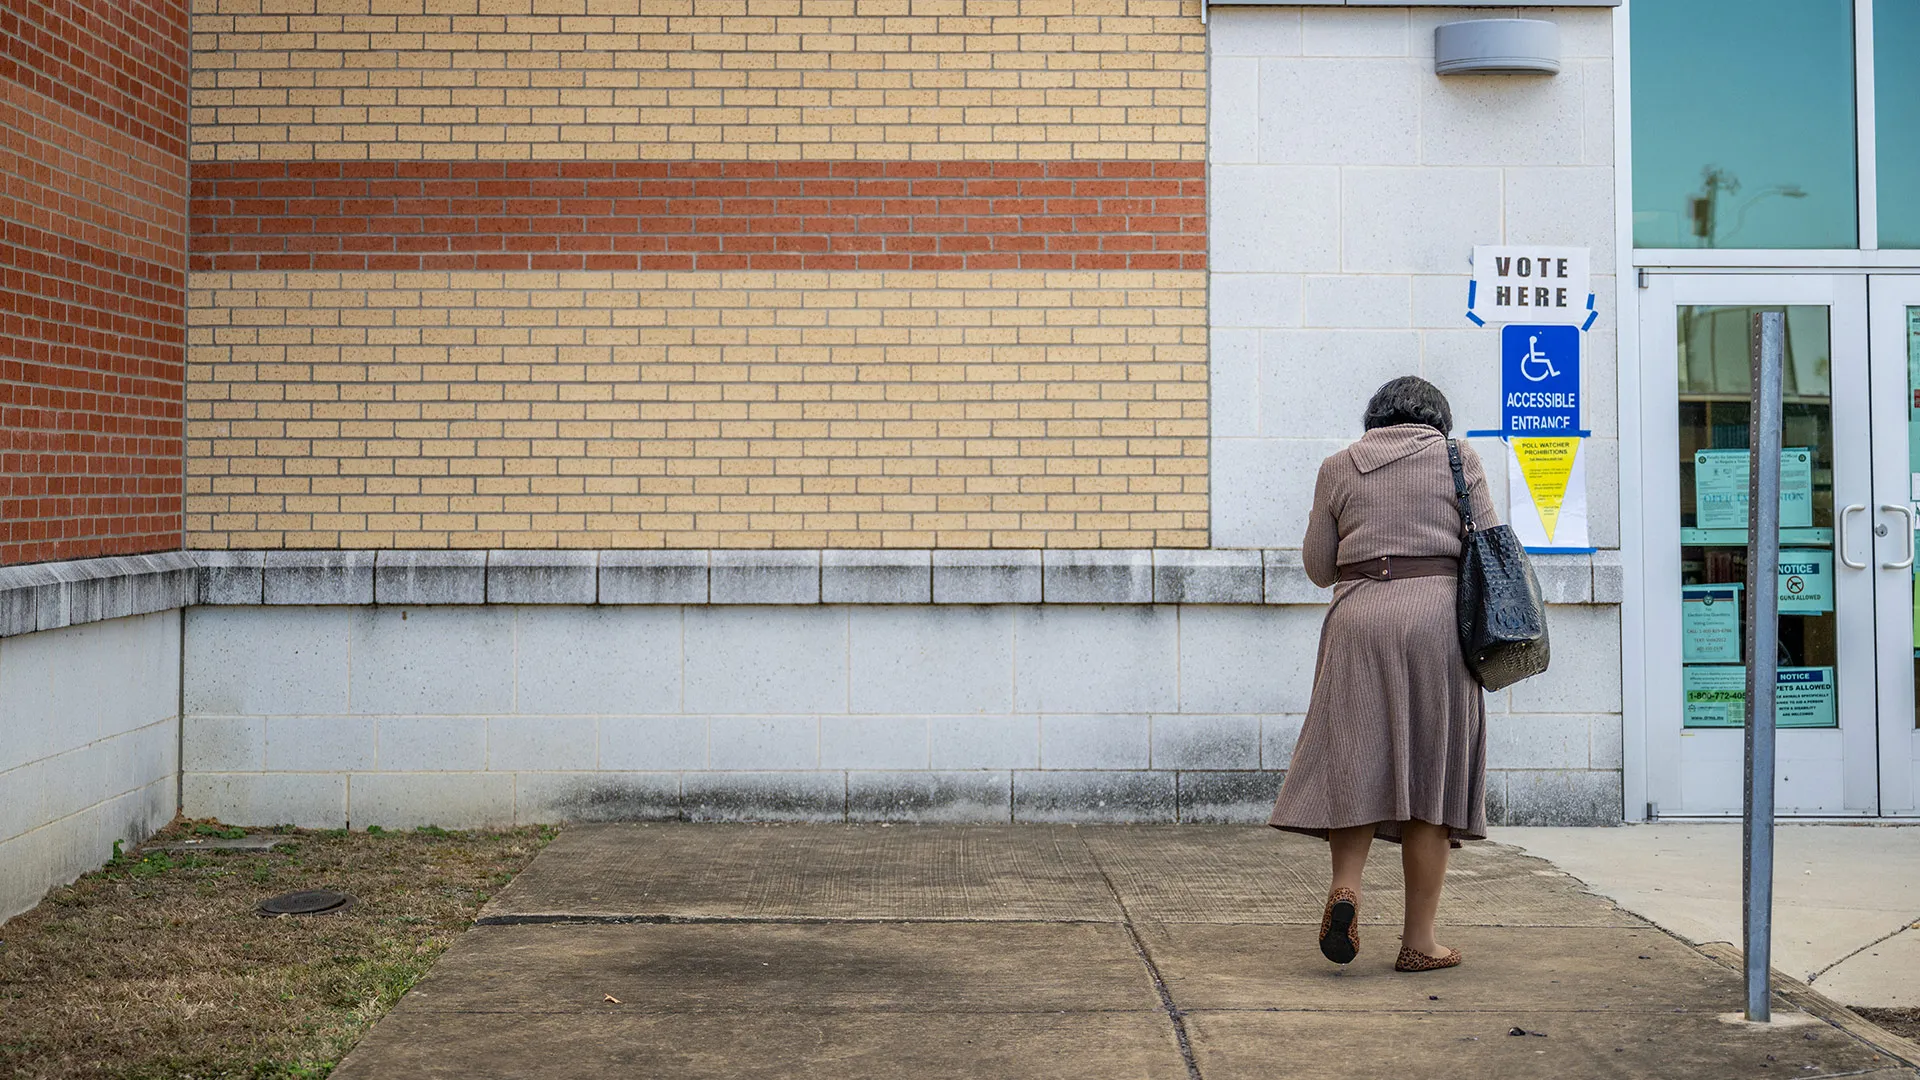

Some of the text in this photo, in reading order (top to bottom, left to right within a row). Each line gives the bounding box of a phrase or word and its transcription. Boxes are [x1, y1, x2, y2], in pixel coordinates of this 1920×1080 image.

[1495, 256, 1568, 278] VOTE
[1496, 286, 1567, 307] HERE
[1506, 392, 1576, 408] ACCESSIBLE
[1511, 415, 1571, 430] ENTRANCE
[1778, 564, 1813, 574] NOTICE
[1780, 672, 1810, 680] NOTICE
[1689, 691, 1746, 700] 1-800-772-405
